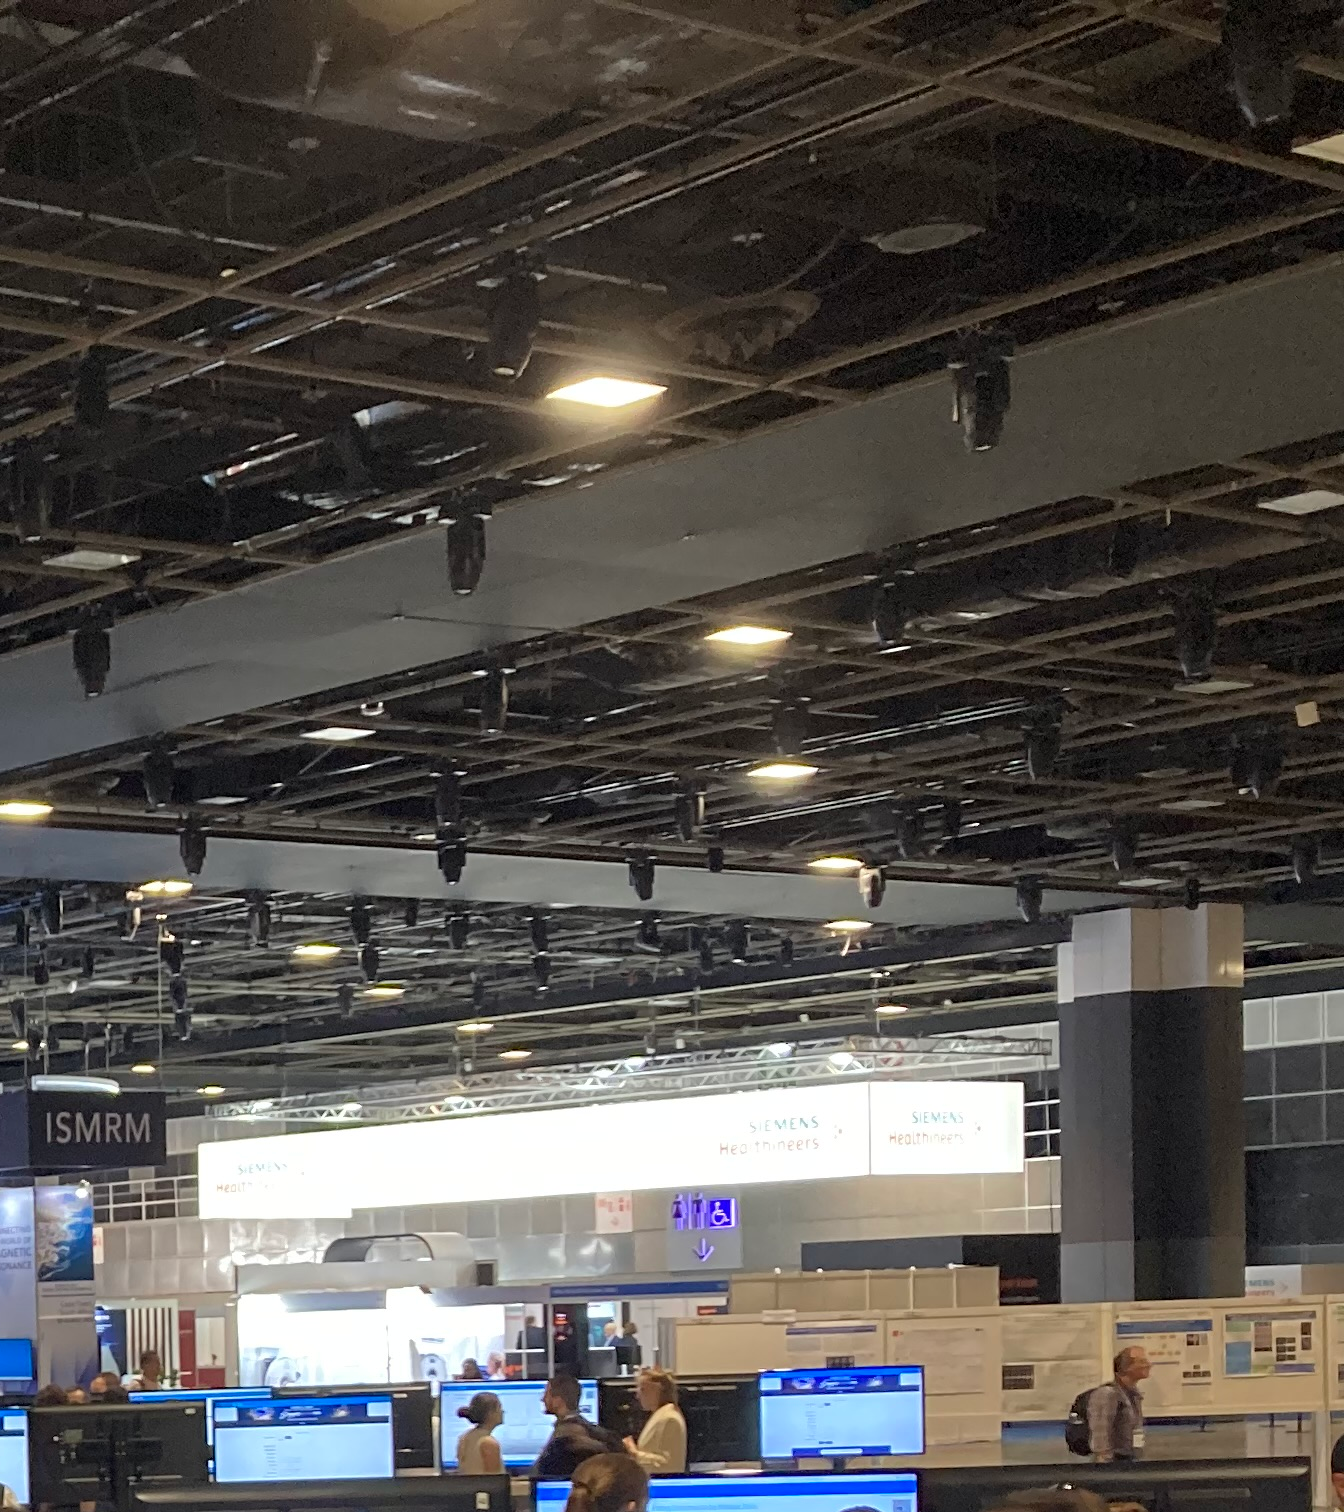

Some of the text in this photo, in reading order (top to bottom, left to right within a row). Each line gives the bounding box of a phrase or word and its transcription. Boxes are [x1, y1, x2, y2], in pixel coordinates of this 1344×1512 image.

[750, 1116, 819, 1133] SIEMENS
[912, 1111, 964, 1124] SIEMENS
[46, 1112, 151, 1143] ISMRM
[889, 1131, 964, 1145] Healthineers
